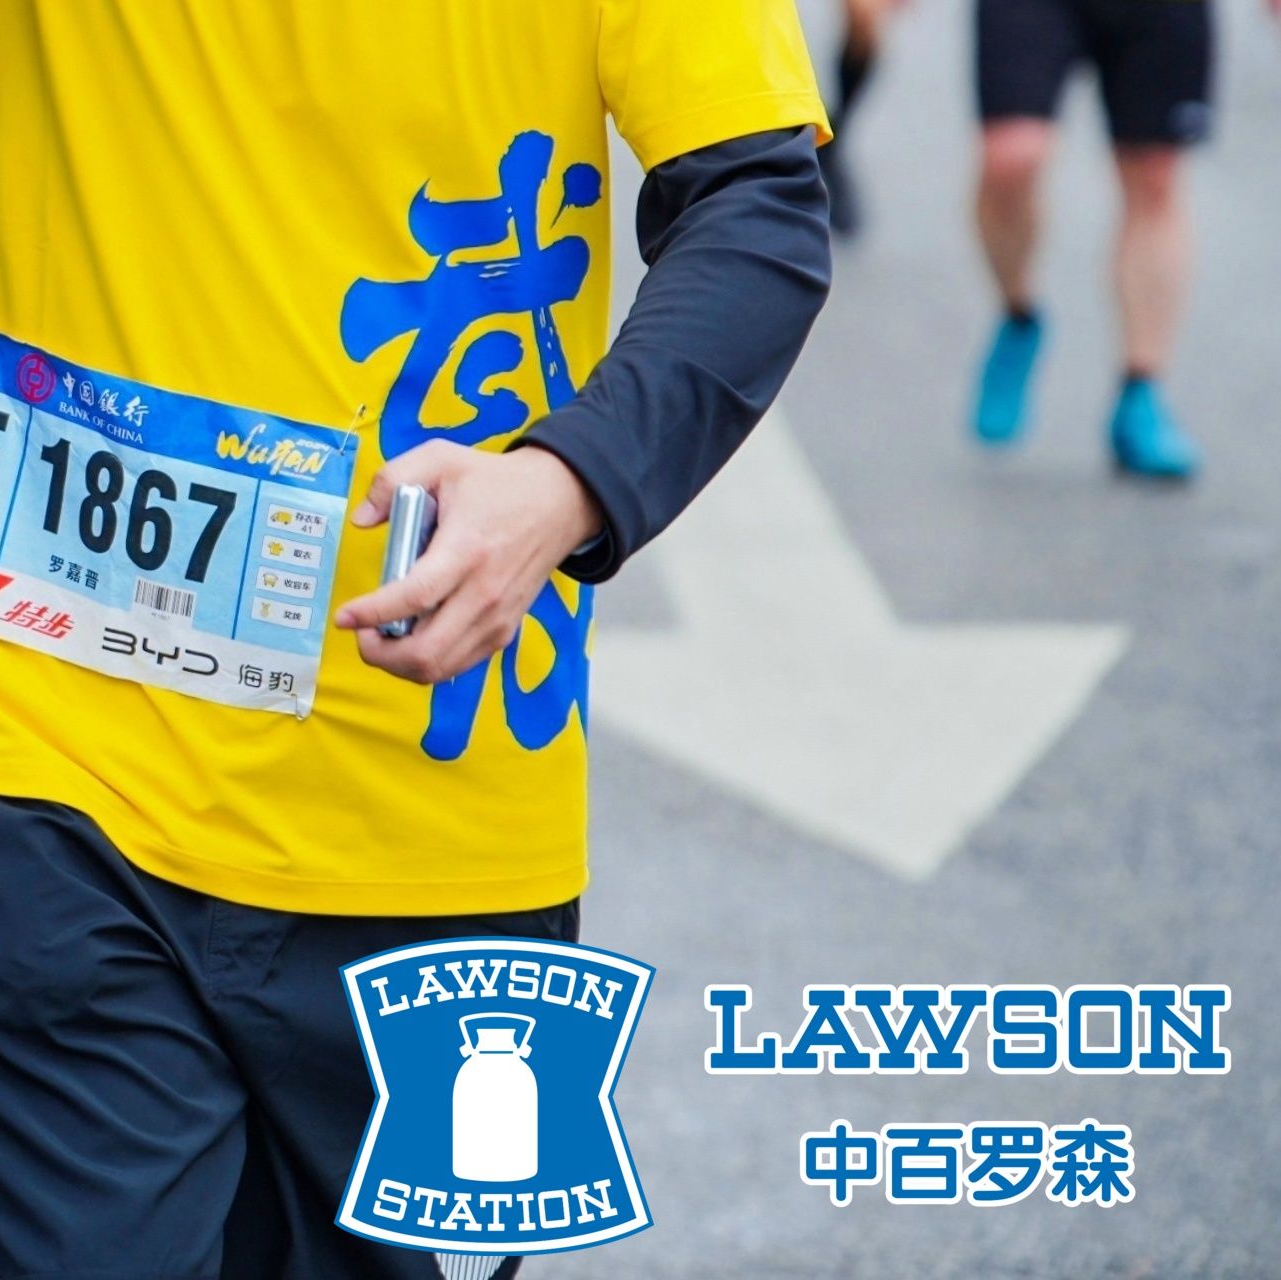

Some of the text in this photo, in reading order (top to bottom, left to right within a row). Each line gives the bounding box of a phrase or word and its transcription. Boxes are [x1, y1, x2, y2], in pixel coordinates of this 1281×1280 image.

[62, 371, 150, 427] 中国银行
[58, 401, 144, 444] BANK OF CHINA
[40, 437, 238, 583] 1867
[301, 524, 312, 534] 41
[47, 554, 100, 590] 罗嘉晋
[101, 626, 220, 677] BYD
[238, 664, 294, 692] 海豹
